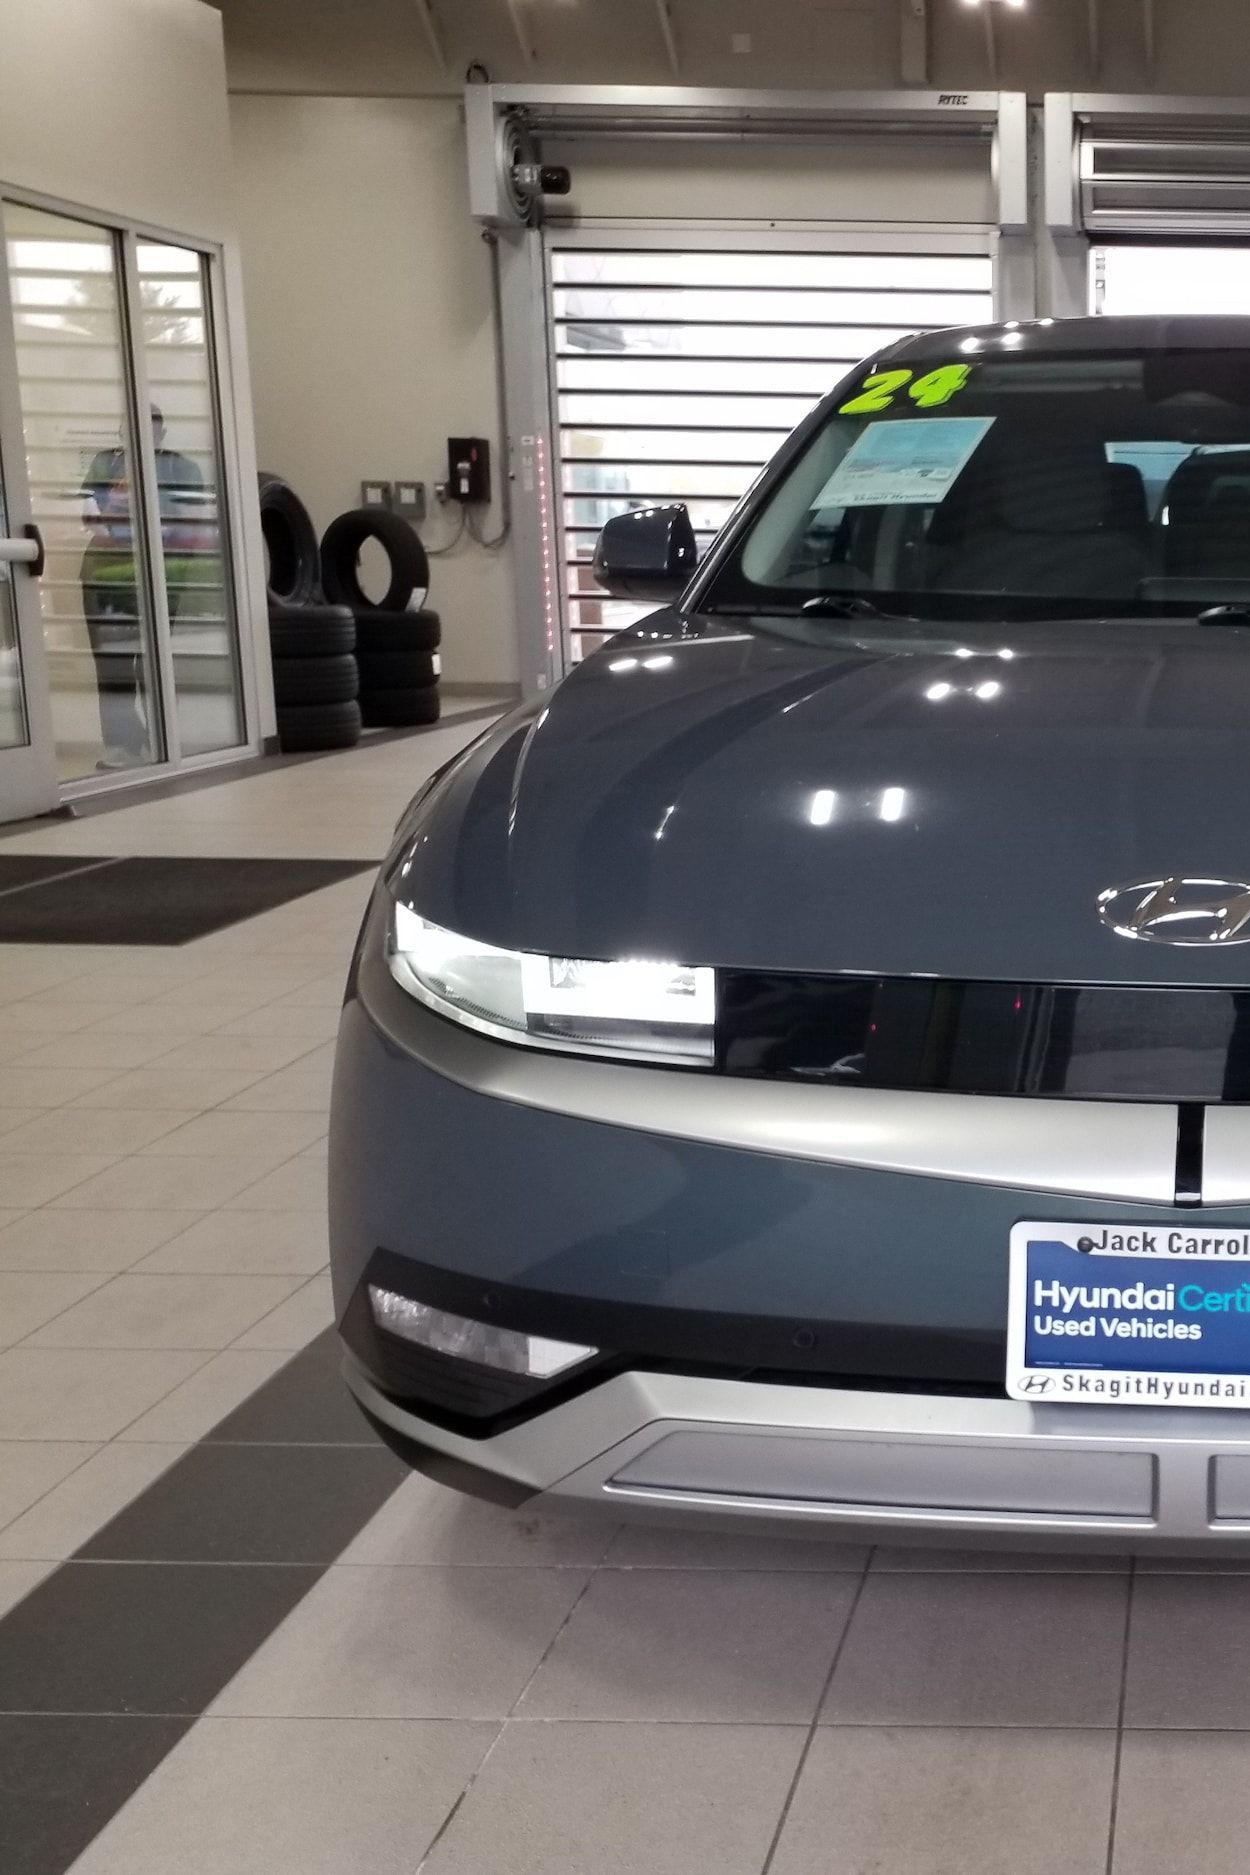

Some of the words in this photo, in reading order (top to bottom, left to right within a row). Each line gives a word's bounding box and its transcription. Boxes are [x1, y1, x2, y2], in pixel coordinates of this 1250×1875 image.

[838, 363, 973, 415] 24
[1094, 1229, 1157, 1253] Jack
[1034, 1279, 1176, 1313] Hyundai
[1034, 1315, 1096, 1337] Used
[1100, 1316, 1203, 1340] Vehicles
